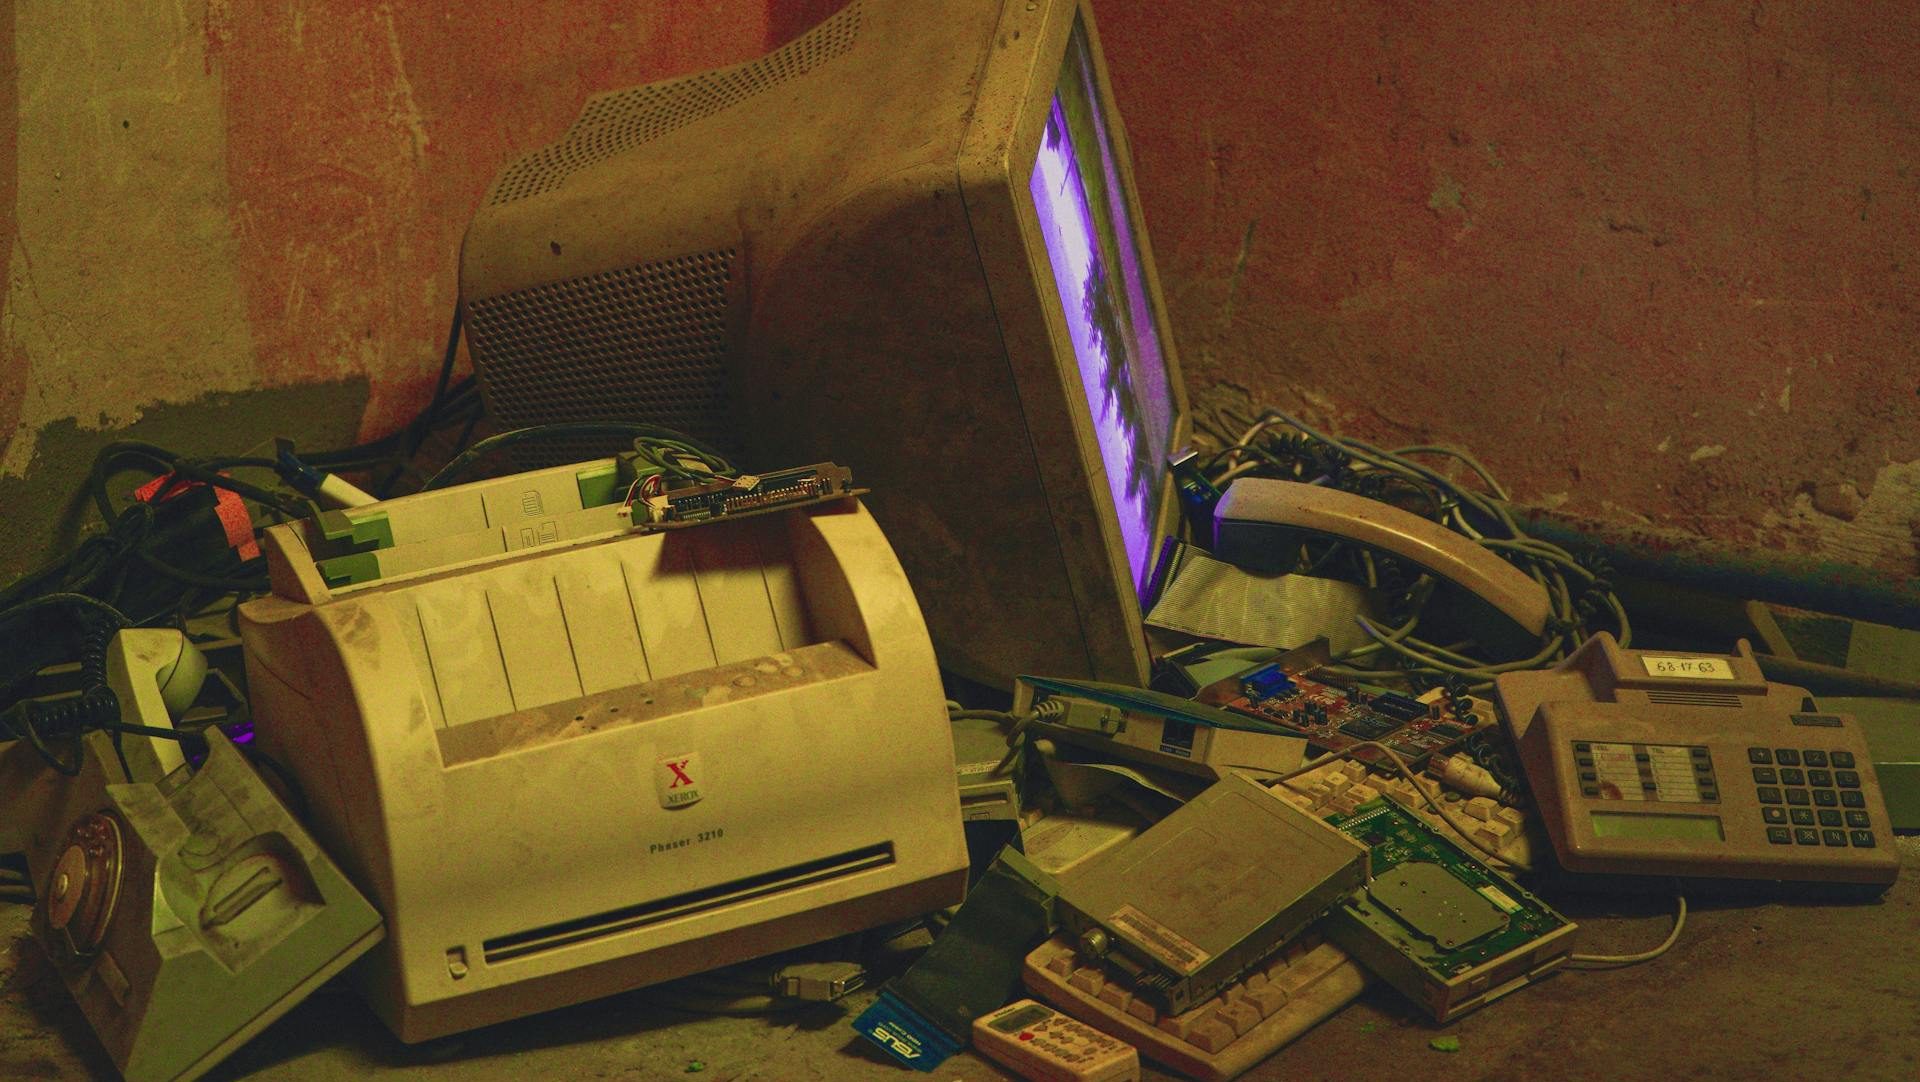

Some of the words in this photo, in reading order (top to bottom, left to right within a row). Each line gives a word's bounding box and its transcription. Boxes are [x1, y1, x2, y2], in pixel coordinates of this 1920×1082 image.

[667, 790, 699, 803] XEROX
[649, 839, 691, 854] Phaser
[697, 828, 724, 843] 3210
[872, 1027, 920, 1059] ASUS
